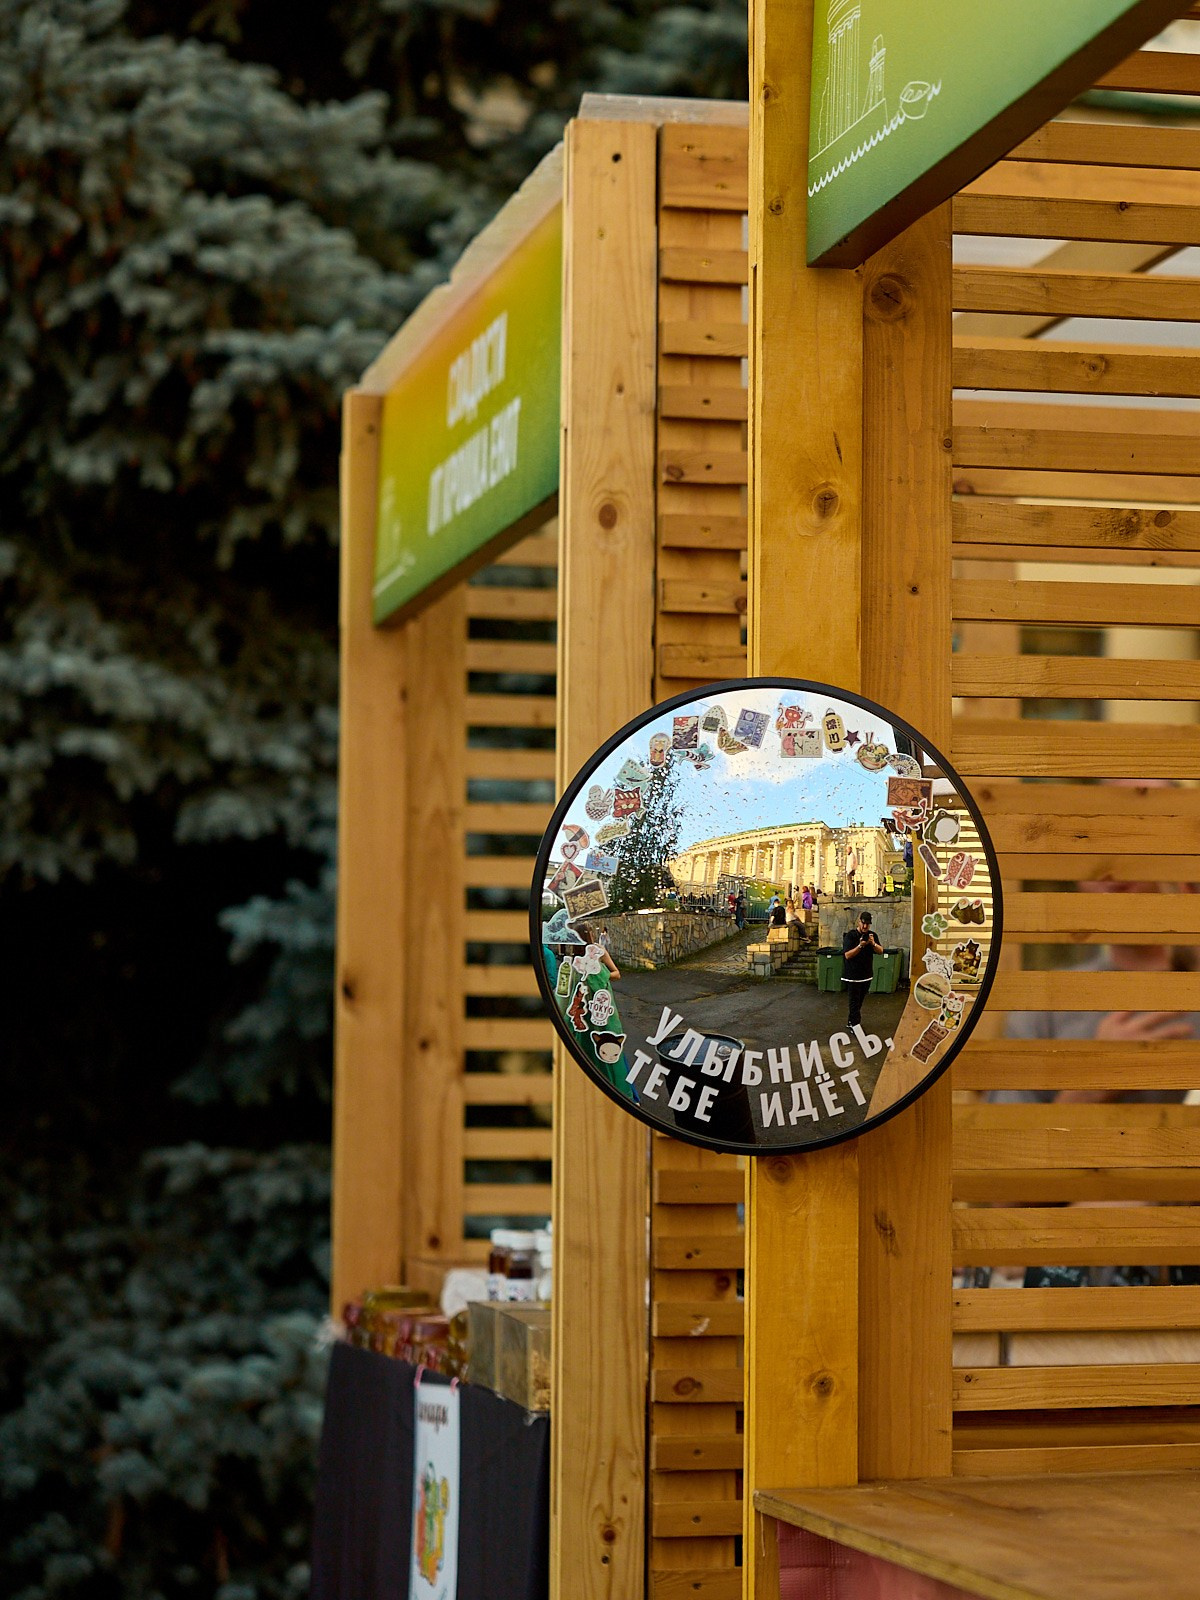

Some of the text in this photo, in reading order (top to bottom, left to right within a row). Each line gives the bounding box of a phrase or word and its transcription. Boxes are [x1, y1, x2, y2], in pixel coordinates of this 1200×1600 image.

[589, 1002, 614, 1015] TOKYO
[645, 1005, 896, 1087] УЛЫБНИСЬ,
[625, 1049, 867, 1128] ТЕБЕ ИДЁТ
